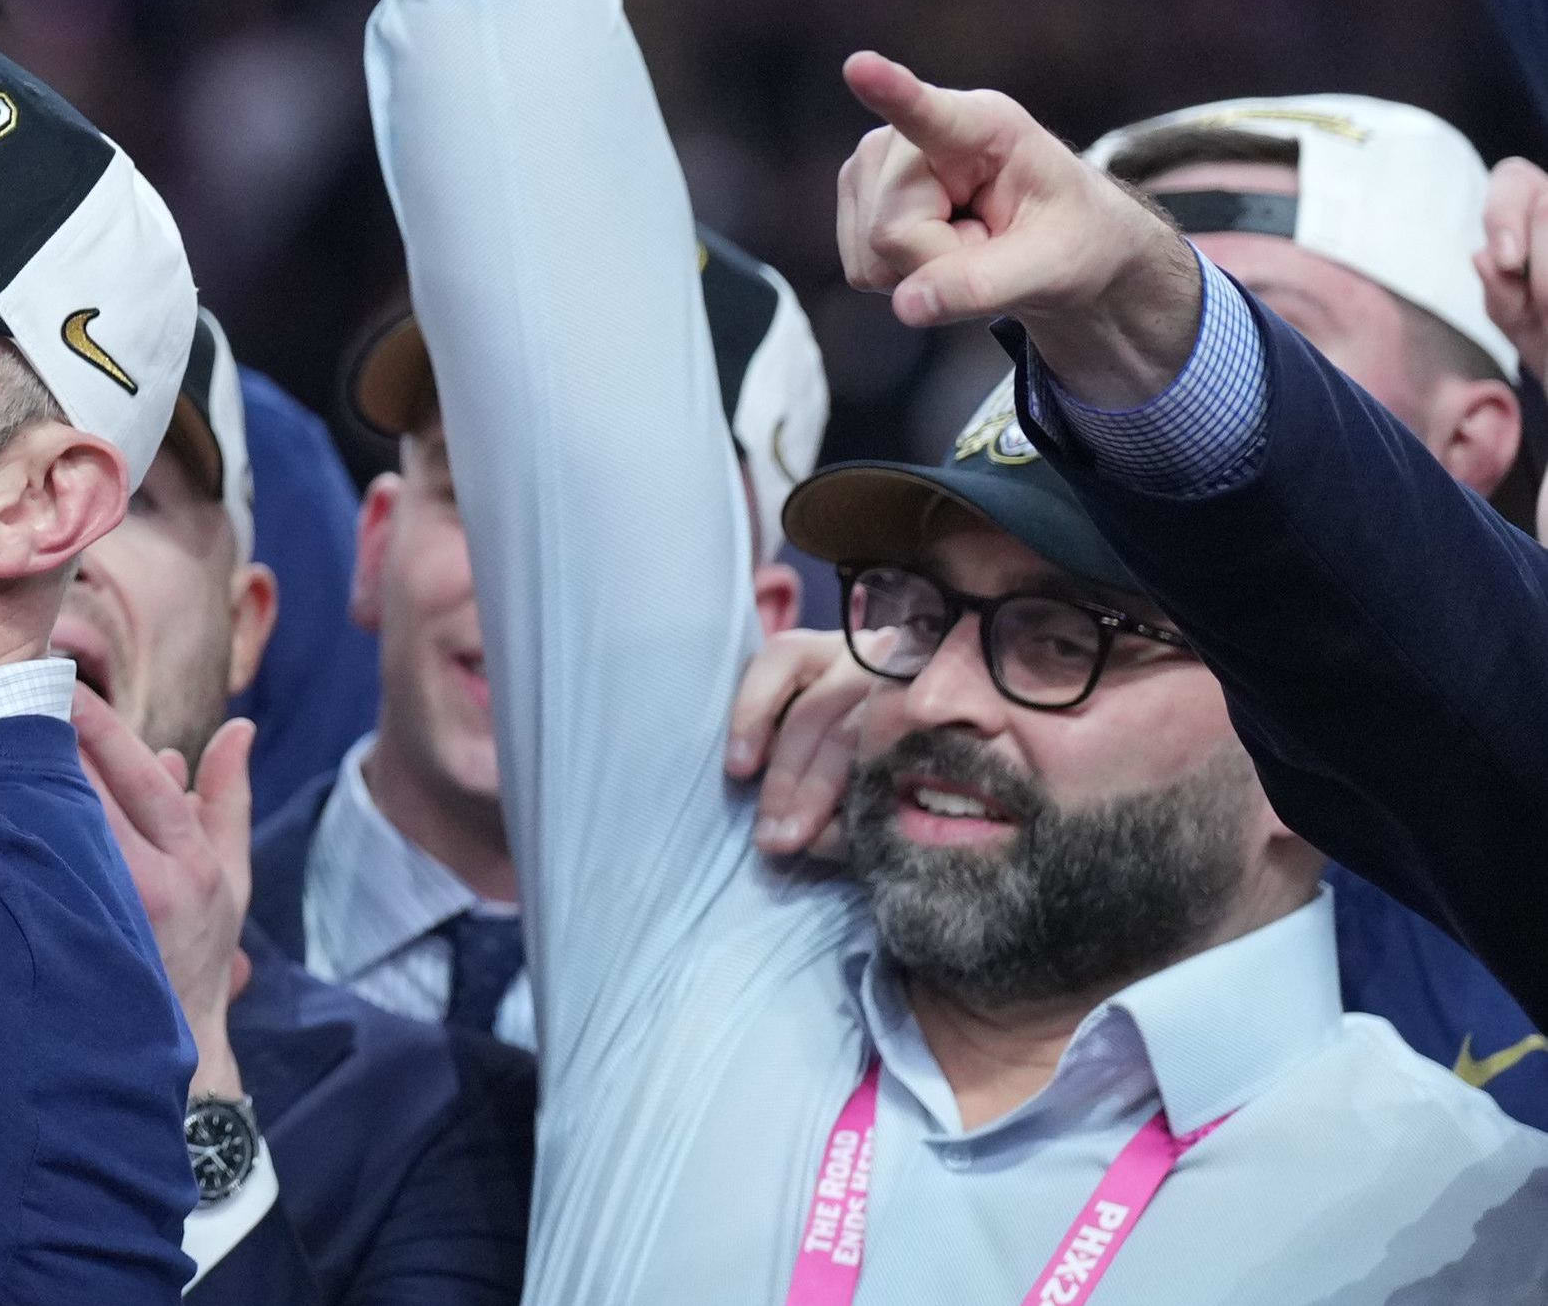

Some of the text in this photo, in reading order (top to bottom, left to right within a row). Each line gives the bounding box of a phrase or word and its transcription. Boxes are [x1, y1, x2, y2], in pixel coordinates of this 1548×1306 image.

[805, 1129, 860, 1253] THE ROAD
[1038, 1199, 1131, 1306] PHX2
